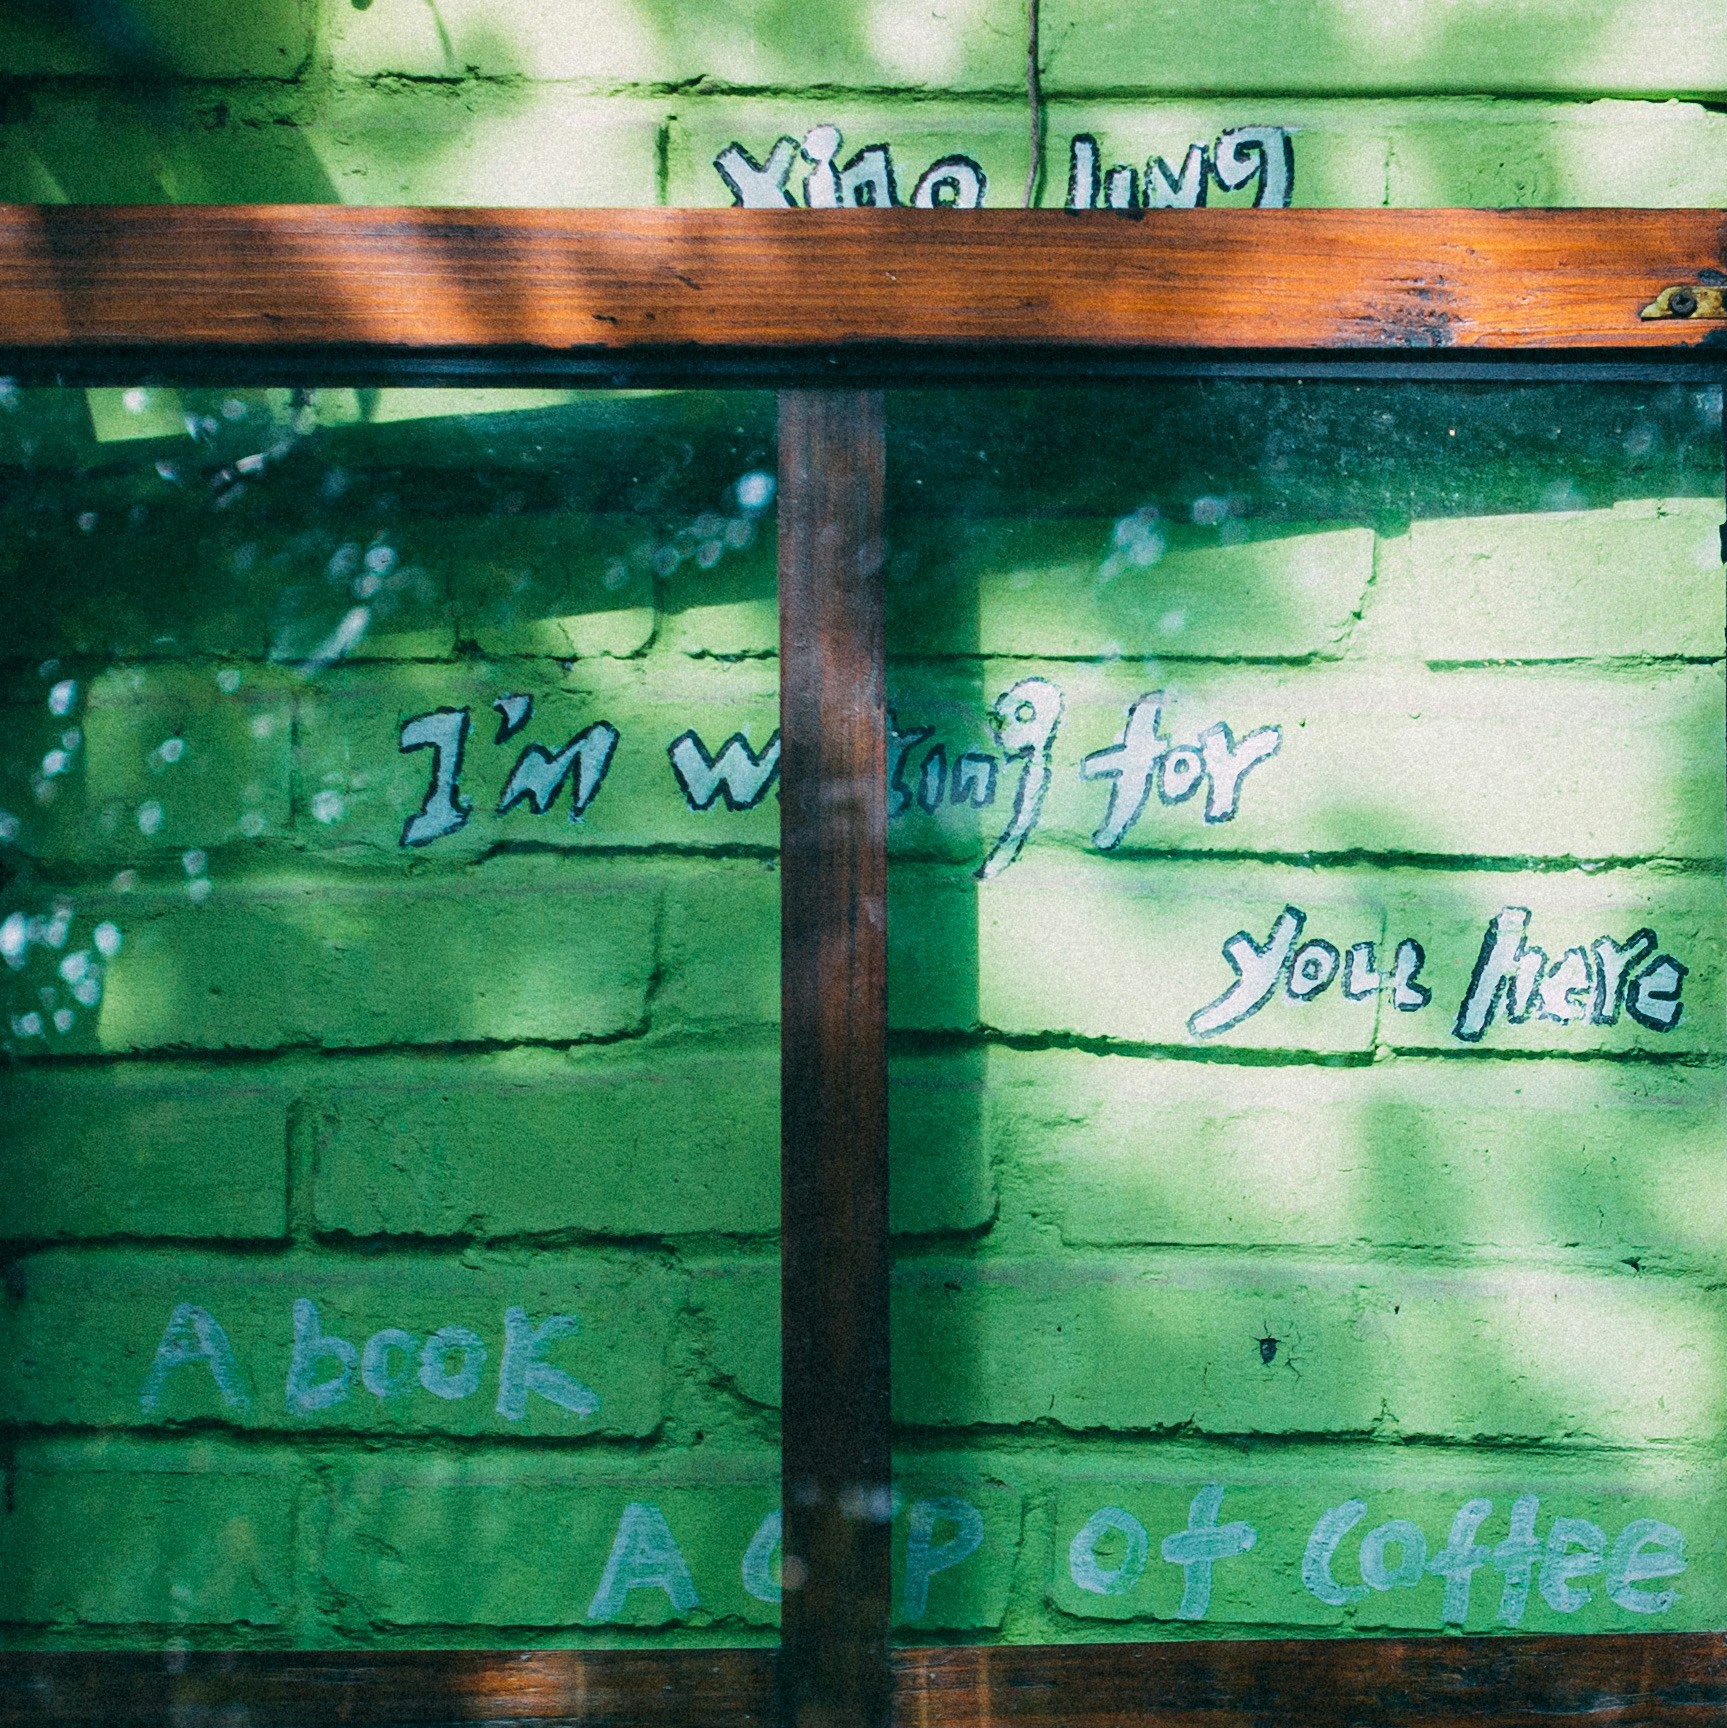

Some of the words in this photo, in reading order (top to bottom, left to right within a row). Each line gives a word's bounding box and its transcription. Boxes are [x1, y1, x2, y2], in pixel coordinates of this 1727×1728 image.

[399, 693, 621, 848] I'm
[1081, 689, 1283, 851] for
[1187, 903, 1433, 1039] you
[1453, 906, 1689, 1042] here
[139, 1302, 252, 1413] A
[587, 1501, 700, 1620] A
